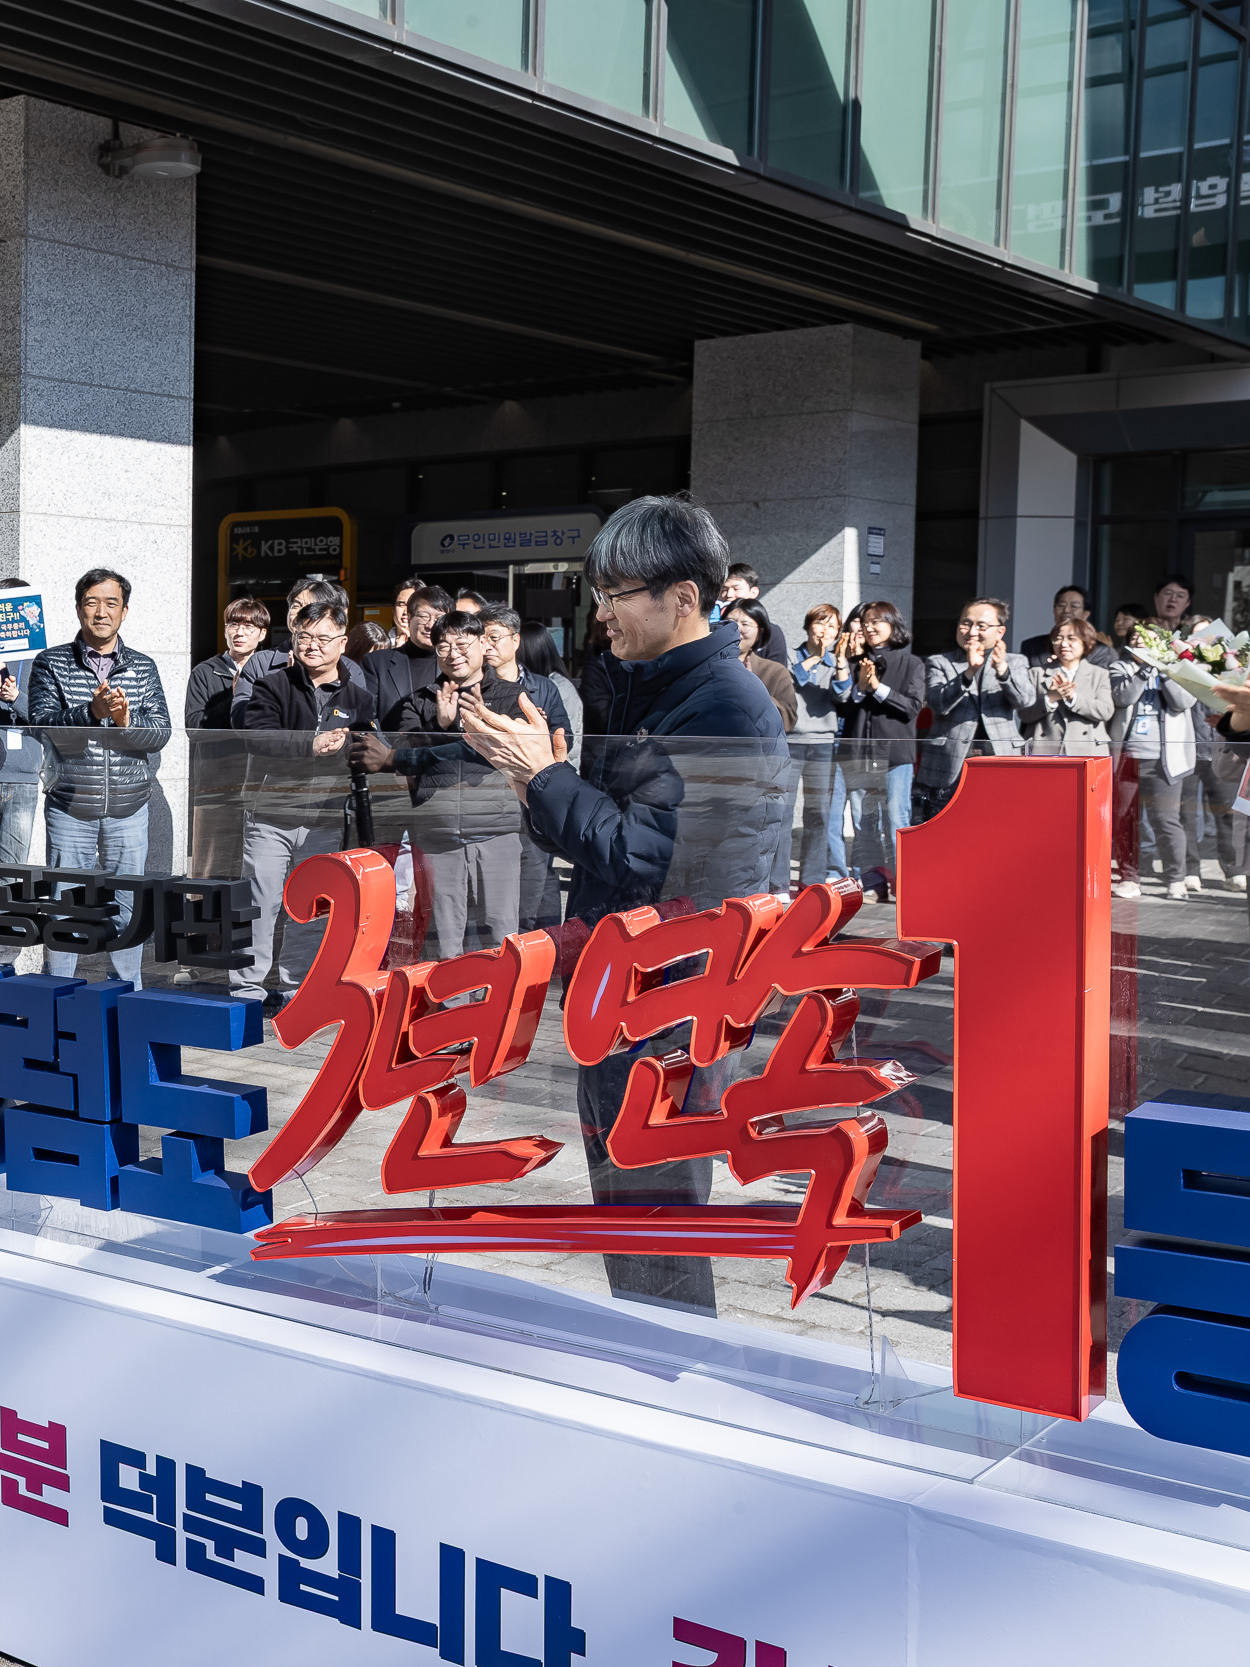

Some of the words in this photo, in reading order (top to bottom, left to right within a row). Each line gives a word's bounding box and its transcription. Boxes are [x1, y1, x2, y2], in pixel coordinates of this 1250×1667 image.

[261, 536, 341, 557] KB국민은행
[457, 529, 581, 549] 무인민원발급창구
[0, 622, 25, 631] 국무총리
[0, 629, 30, 639] 축하합니다
[99, 1438, 586, 1667] 덕분입니다
